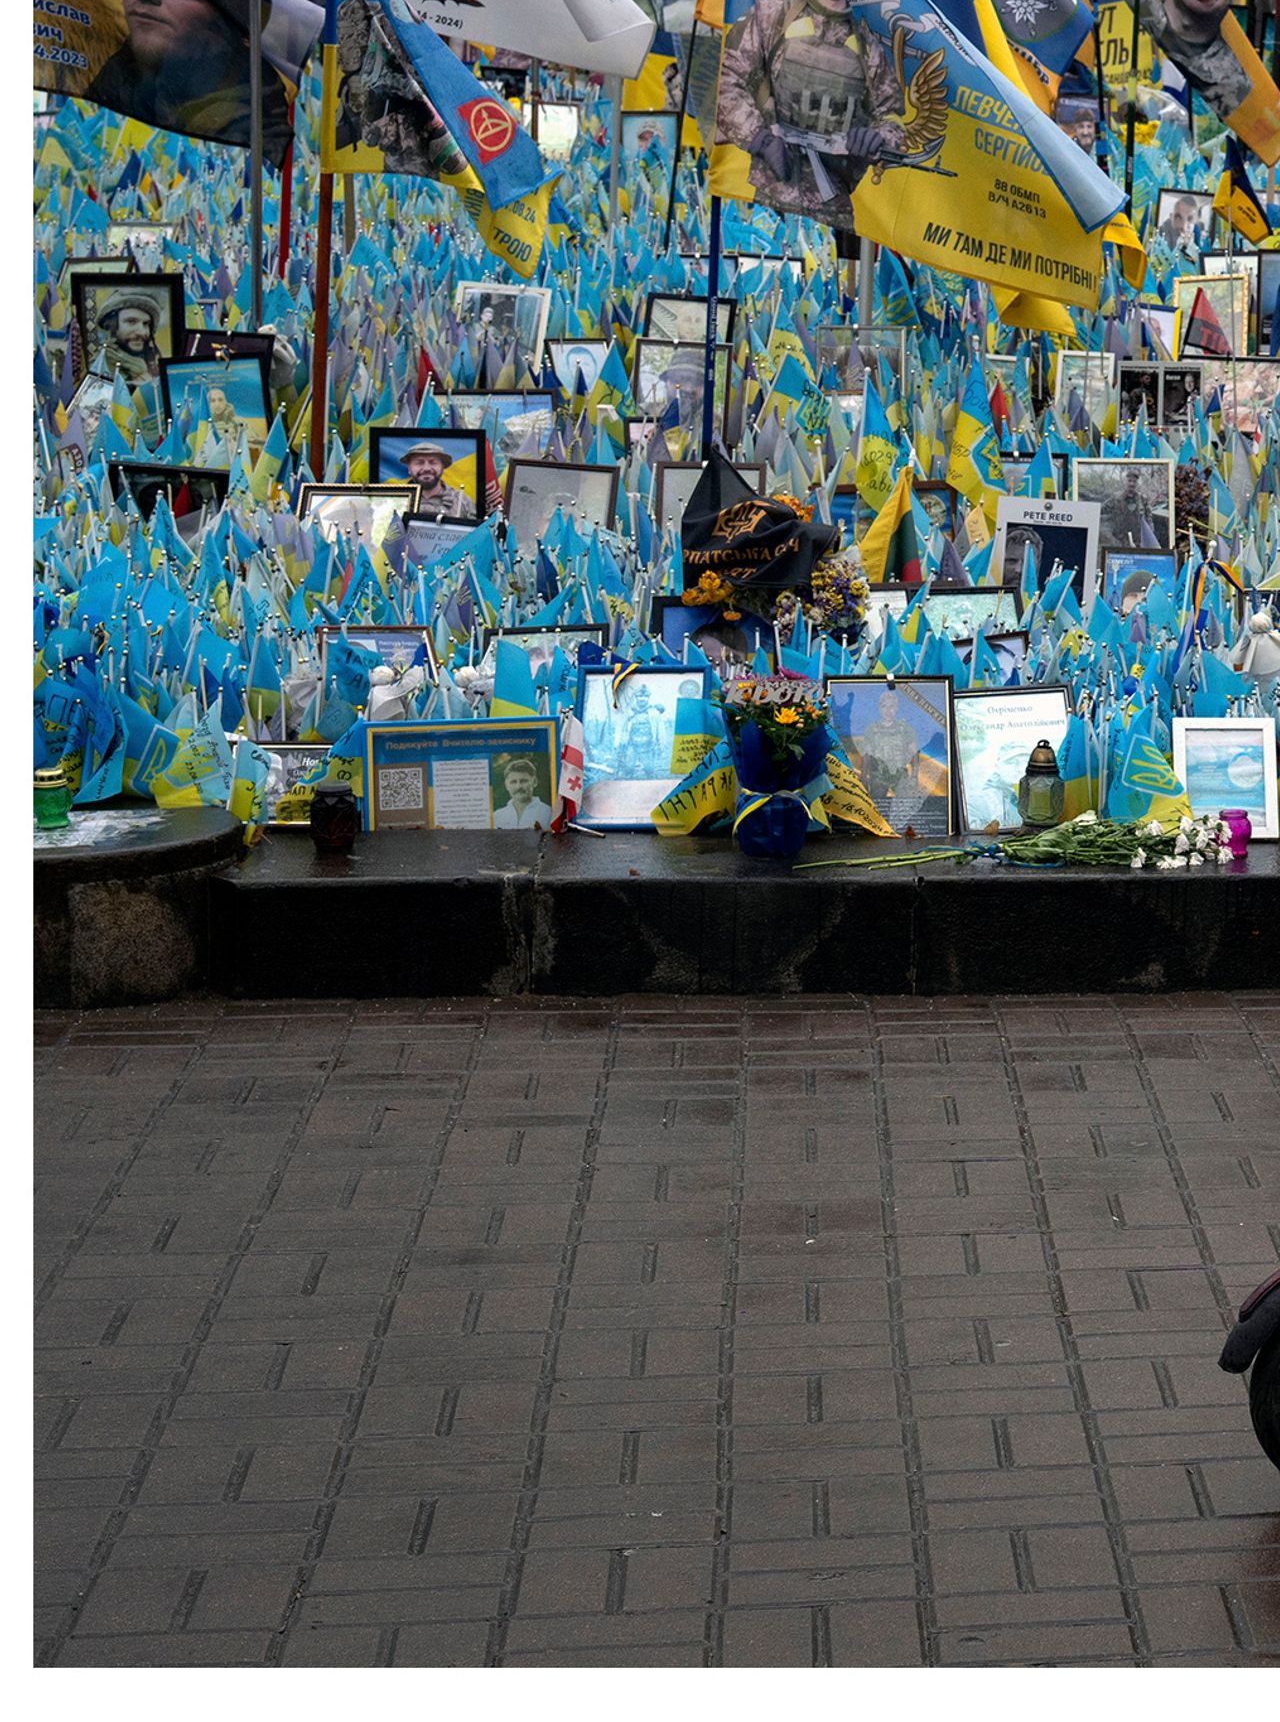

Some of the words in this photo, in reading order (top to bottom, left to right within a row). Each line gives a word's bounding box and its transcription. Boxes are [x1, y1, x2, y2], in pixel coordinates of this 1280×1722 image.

[434, 12, 464, 30] 2024)
[994, 178, 1008, 192] 88
[923, 221, 950, 246] МИ
[953, 230, 984, 258] ТАМ
[986, 243, 1006, 265] ДЕ
[1009, 245, 1033, 270] МИ
[1023, 511, 1046, 521] PETE
[1049, 512, 1074, 523] REED
